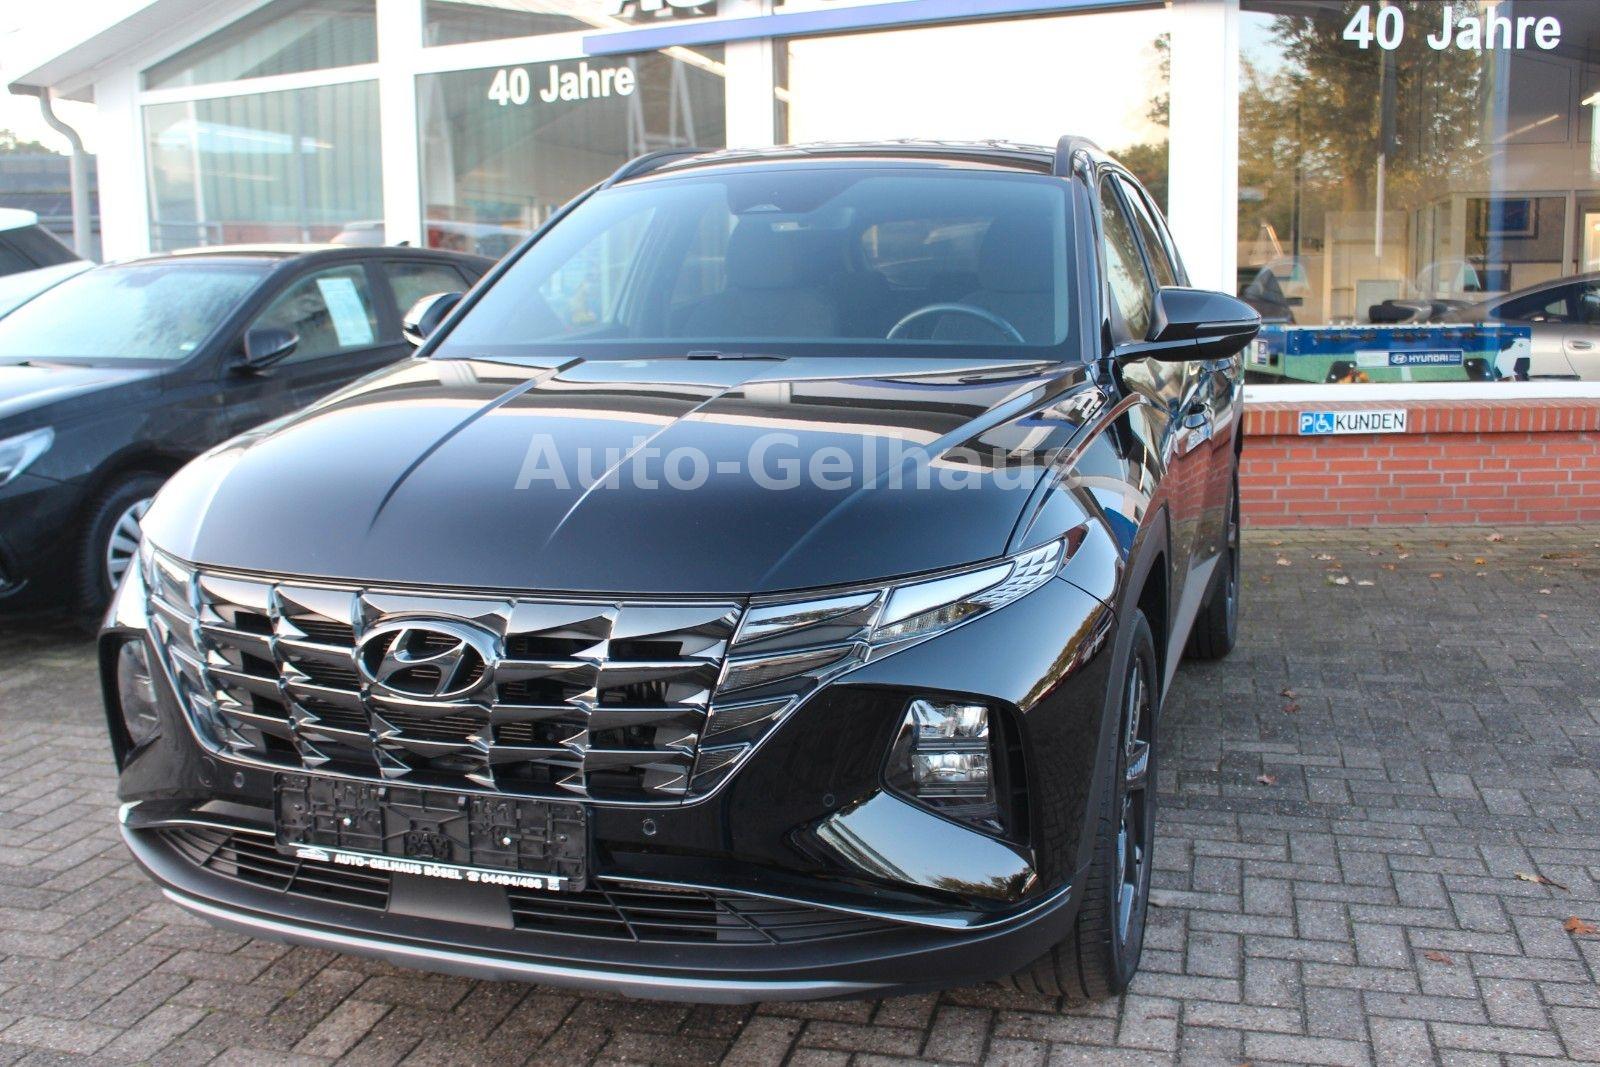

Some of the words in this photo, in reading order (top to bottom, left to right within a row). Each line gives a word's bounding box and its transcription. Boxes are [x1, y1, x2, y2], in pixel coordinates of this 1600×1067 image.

[1342, 5, 1405, 50] 40
[1427, 5, 1562, 51] Jahre
[488, 67, 531, 106] 40
[540, 61, 635, 103] Jahre
[1408, 353, 1449, 363] HYUNDAI
[1336, 413, 1404, 431] KUNDEN
[334, 853, 422, 875] AUTO-GELHAUS
[424, 864, 463, 880] BÖSEL
